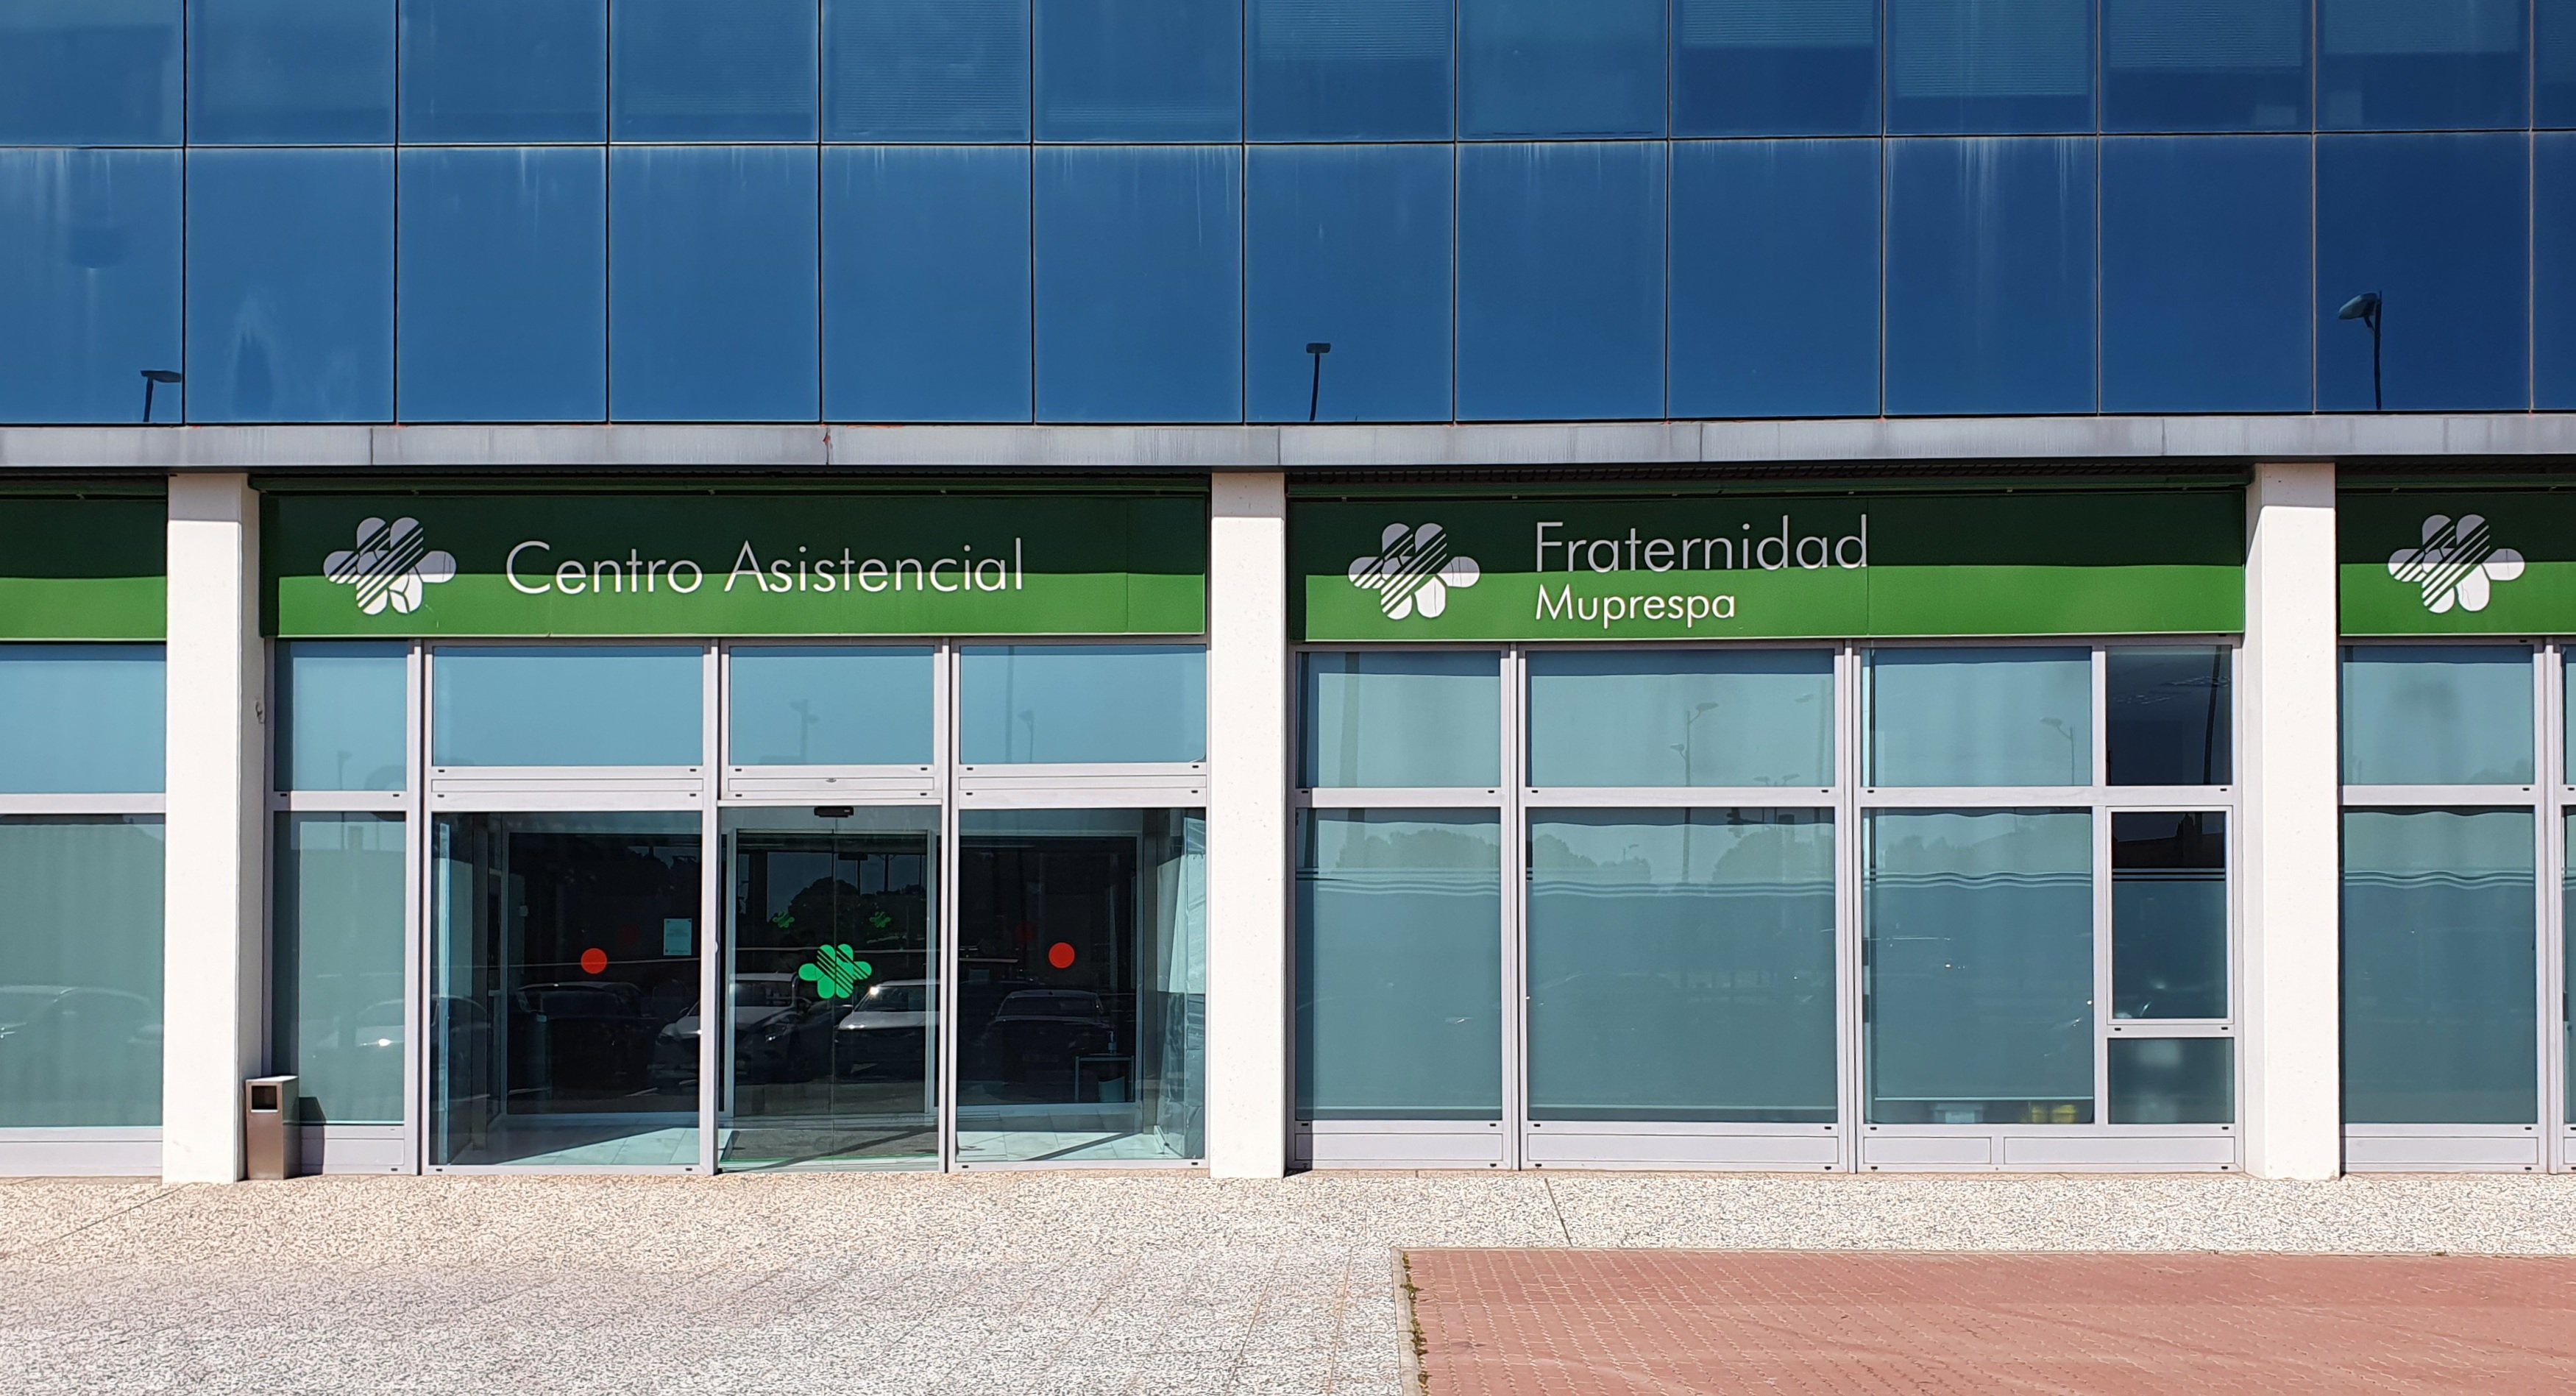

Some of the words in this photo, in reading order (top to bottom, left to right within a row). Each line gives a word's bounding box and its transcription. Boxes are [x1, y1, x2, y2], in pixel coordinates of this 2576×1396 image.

[505, 540, 704, 595] Centro
[723, 537, 1023, 595] Asistencial
[1535, 514, 1868, 574] Fraternidad
[1534, 582, 1736, 630] Muprespa
